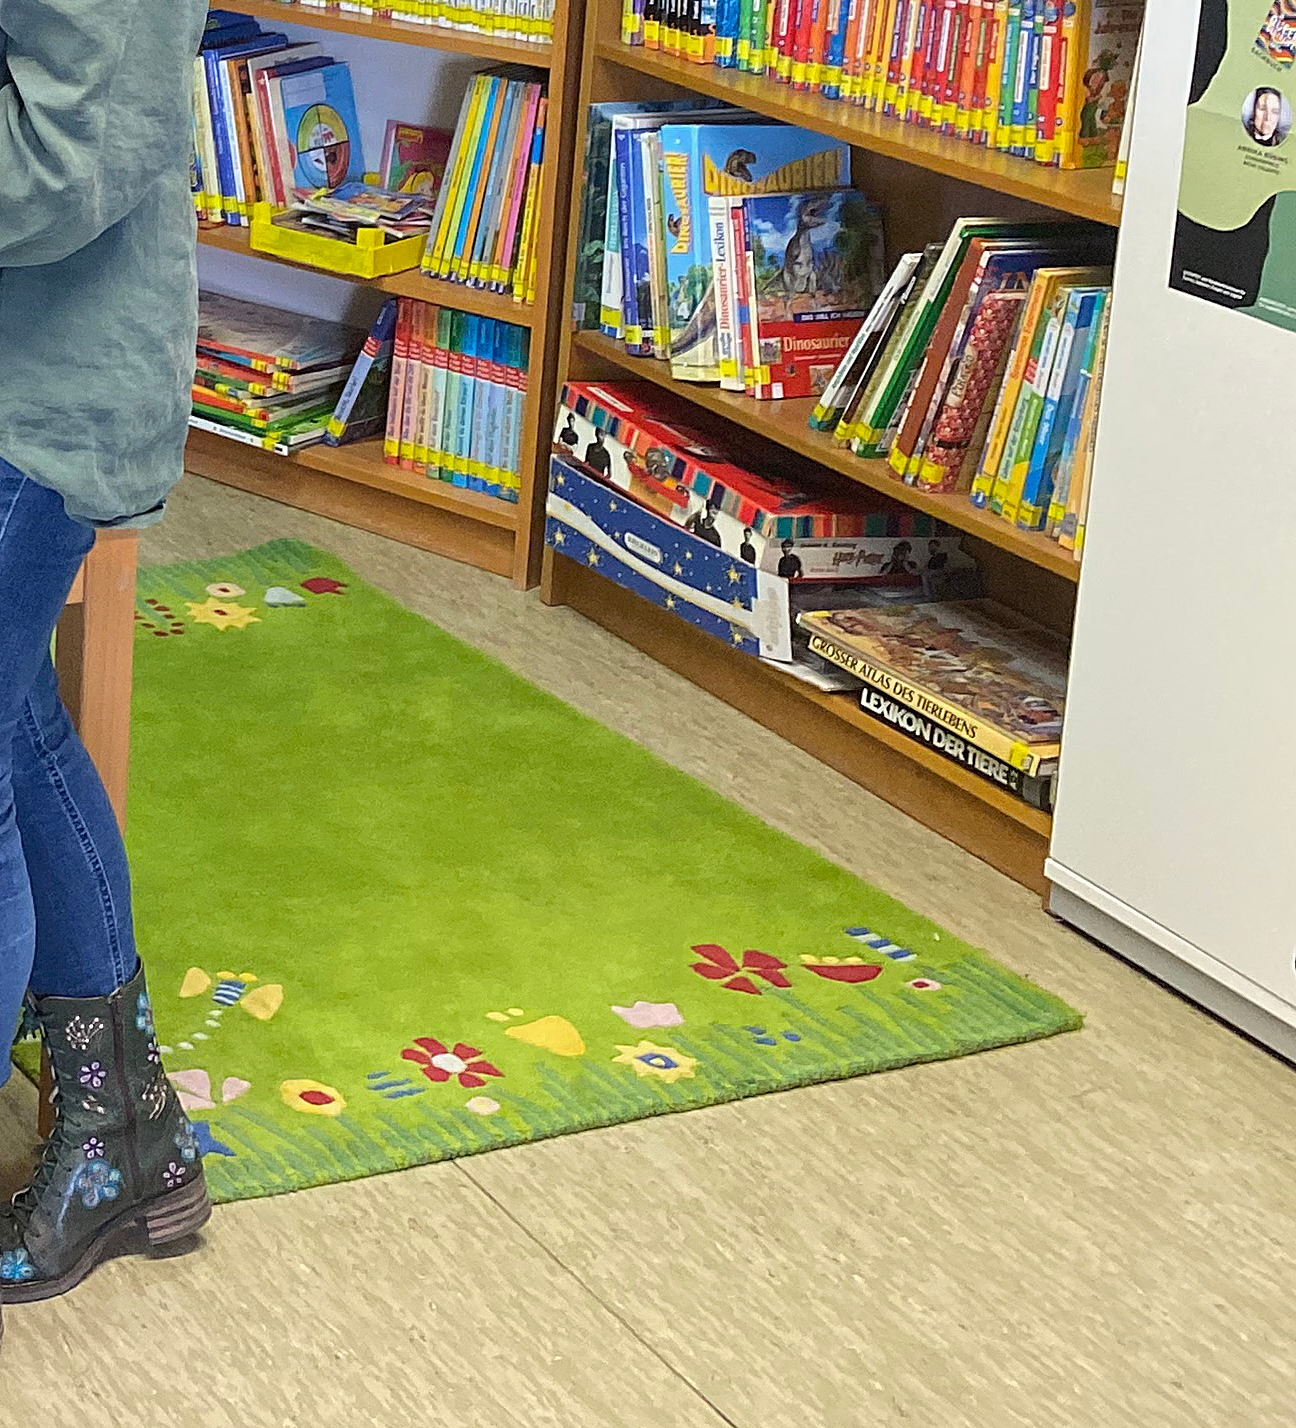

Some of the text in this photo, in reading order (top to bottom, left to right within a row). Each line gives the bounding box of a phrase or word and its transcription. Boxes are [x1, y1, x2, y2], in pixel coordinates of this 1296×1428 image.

[713, 222, 730, 330] Dinosaurier-Lexikon
[783, 335, 851, 352] Dinosaurier
[811, 635, 979, 739] GROSSER ATLAS DES TIERLEBENS
[861, 688, 1010, 784] LEXIKON DER TIERE
